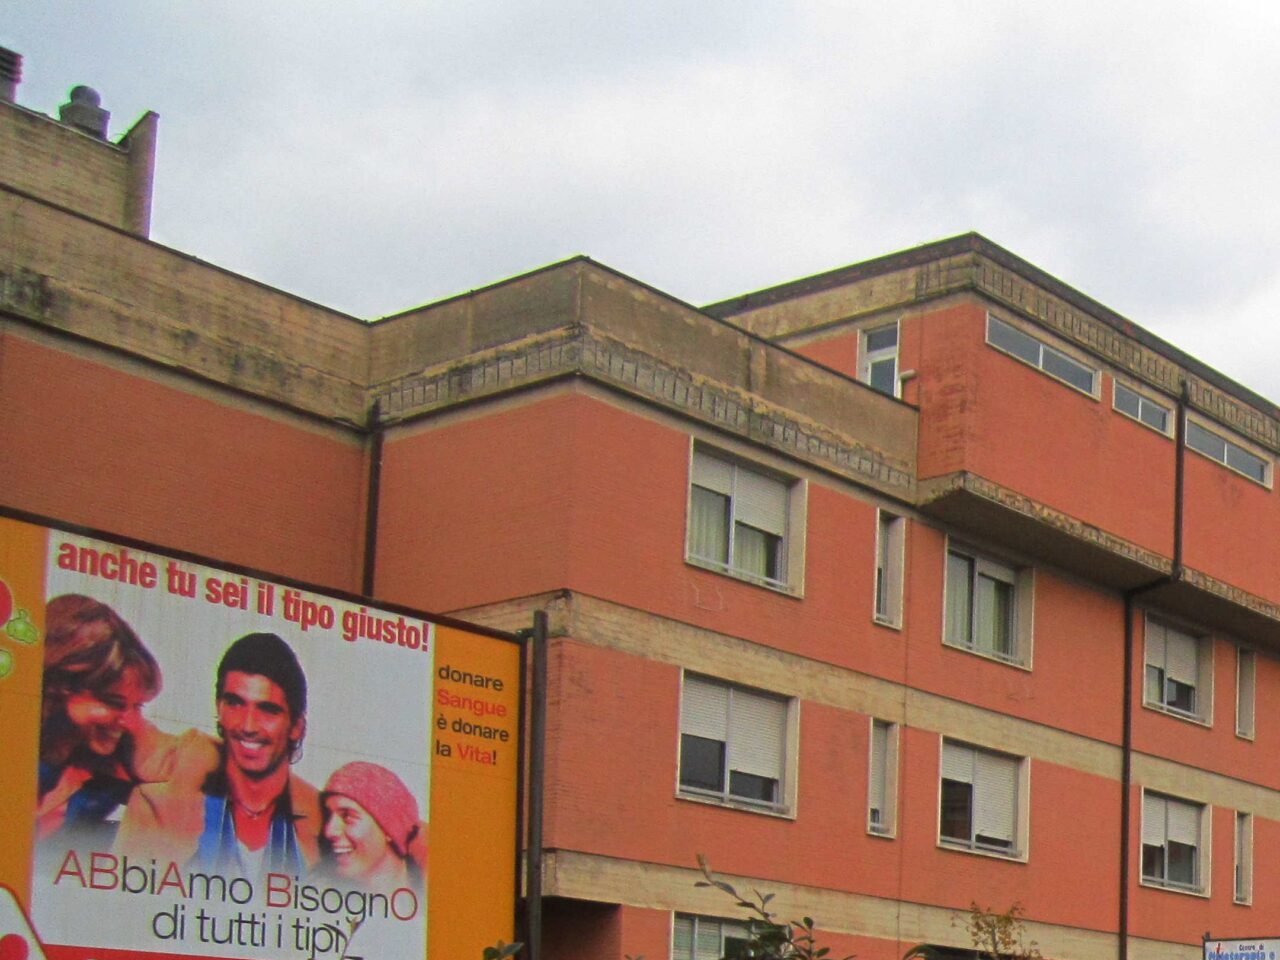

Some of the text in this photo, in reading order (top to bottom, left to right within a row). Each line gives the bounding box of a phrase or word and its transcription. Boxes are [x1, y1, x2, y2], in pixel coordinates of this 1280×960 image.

[57, 542, 430, 652] anche tu sei il tipo giusto!
[438, 665, 504, 691] donare
[436, 688, 507, 718] Sangue
[437, 713, 510, 742] è donare
[435, 740, 497, 766] la Vita!
[53, 849, 419, 923] ABbiAmo BisognO
[152, 904, 186, 941] di
[196, 908, 266, 948] tutti
[277, 914, 283, 949] i
